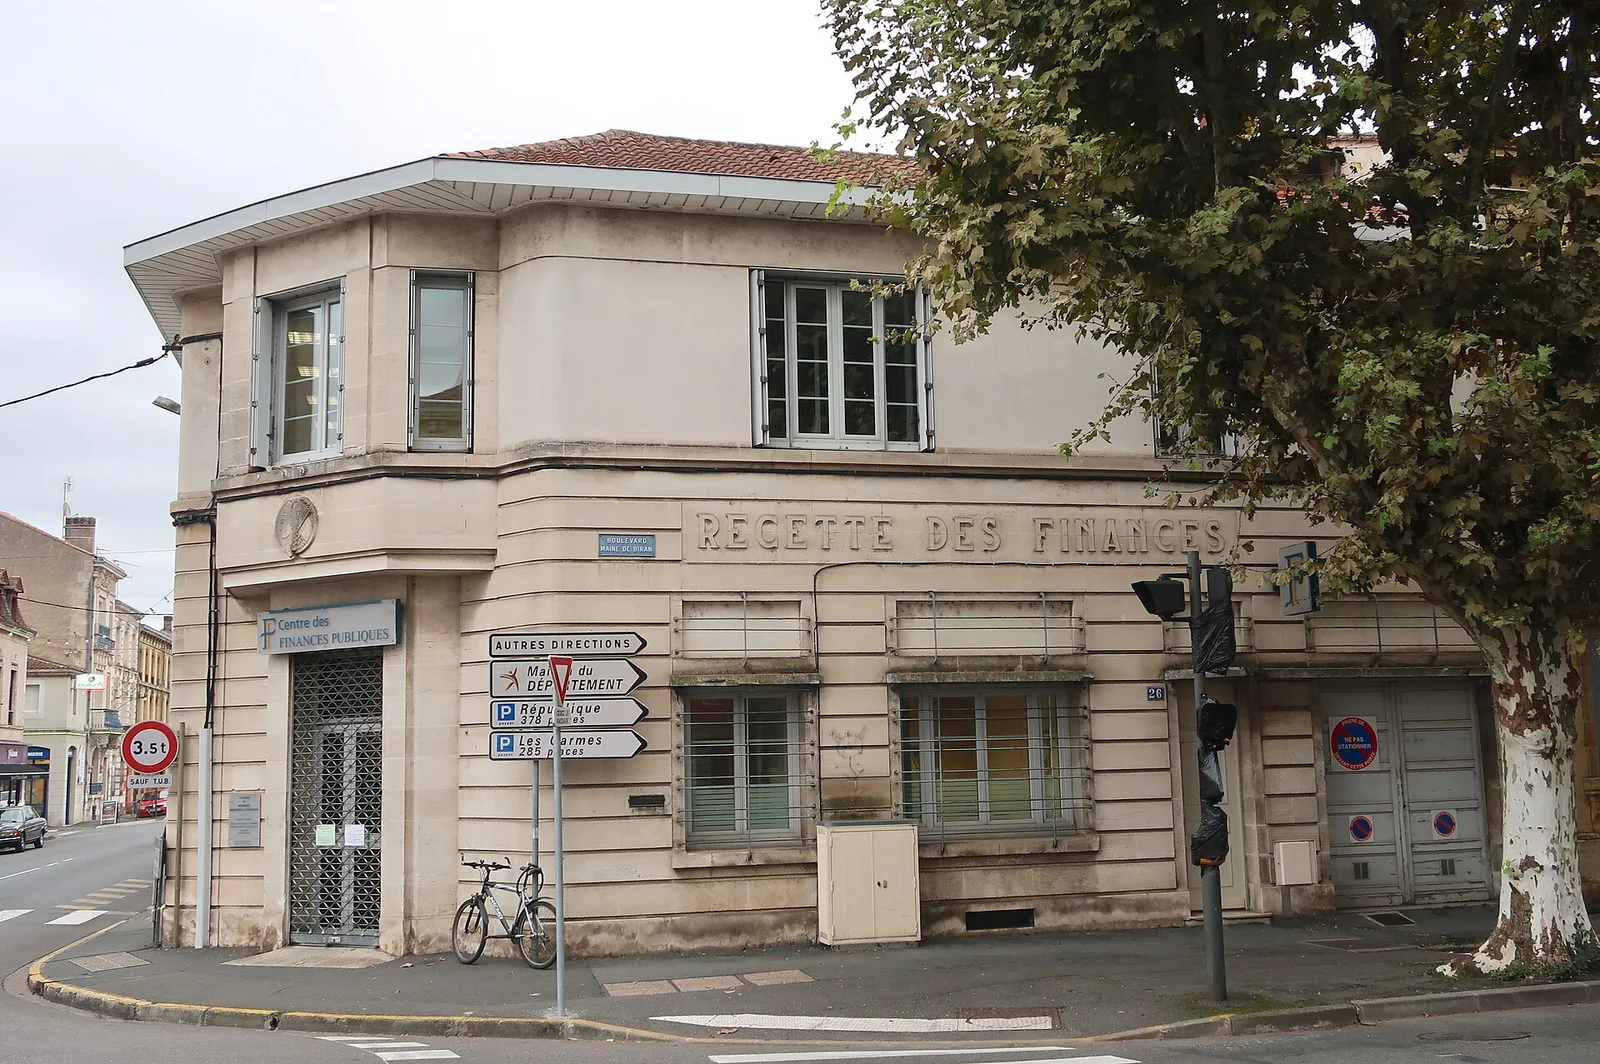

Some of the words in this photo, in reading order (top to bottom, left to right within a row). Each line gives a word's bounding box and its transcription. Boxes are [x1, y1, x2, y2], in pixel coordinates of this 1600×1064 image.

[696, 513, 893, 550] RECETTE
[925, 516, 1001, 551] DES
[1032, 517, 1226, 553] FINANCES
[278, 618, 310, 631] Centre
[312, 616, 330, 628] des
[280, 633, 329, 648] FINANCES
[331, 628, 389, 643] PUBLIQUES
[495, 640, 545, 650] AUTRES
[551, 639, 631, 649] DIRECTIONS
[527, 664, 573, 677] Mai
[578, 664, 593, 676] du
[527, 677, 624, 692] DÉPTEMENT
[1149, 688, 1162, 699] 26
[520, 703, 601, 717] Répuique
[520, 716, 542, 725] 378
[547, 716, 585, 727] pes
[519, 735, 542, 746] Les
[519, 746, 542, 757] 285
[547, 747, 585, 759] paces
[130, 778, 149, 786] SAUF
